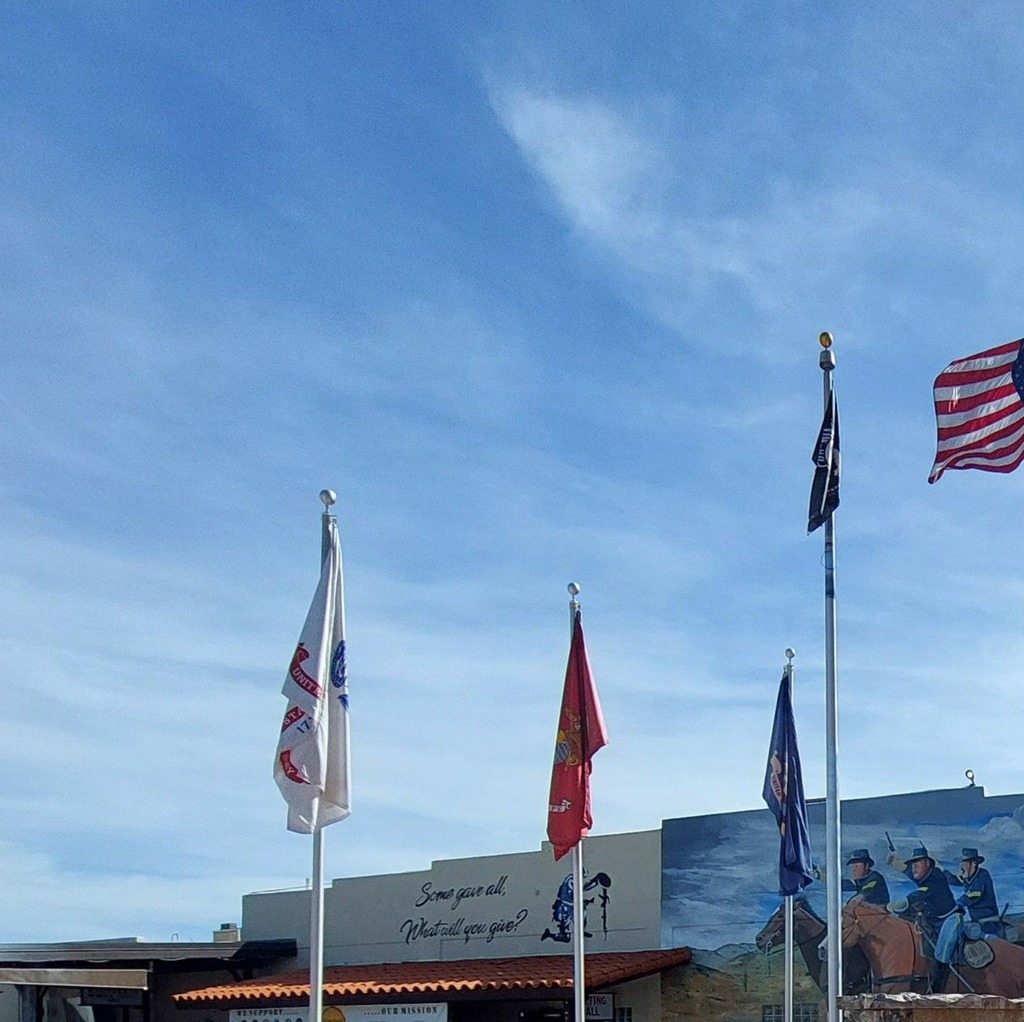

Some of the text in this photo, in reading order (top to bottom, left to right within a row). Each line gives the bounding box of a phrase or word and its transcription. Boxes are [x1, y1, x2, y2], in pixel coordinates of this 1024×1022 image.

[416, 875, 508, 910] Some gave all,
[400, 909, 528, 945] What will you give?
[400, 1006, 438, 1015] MISSION
